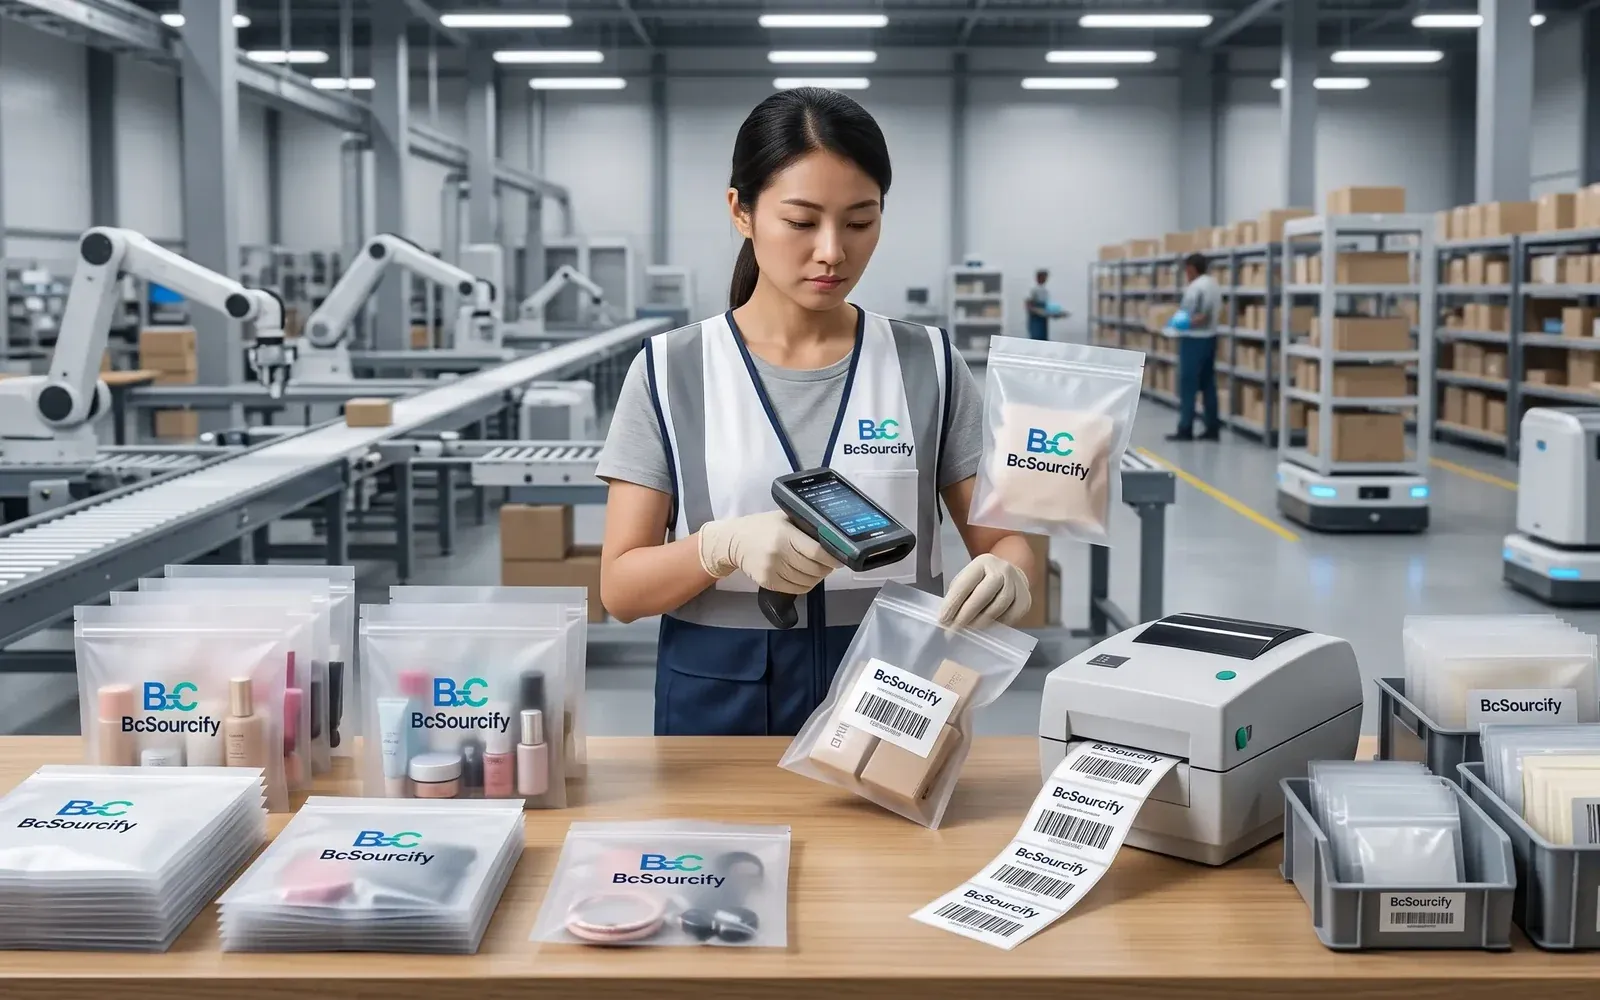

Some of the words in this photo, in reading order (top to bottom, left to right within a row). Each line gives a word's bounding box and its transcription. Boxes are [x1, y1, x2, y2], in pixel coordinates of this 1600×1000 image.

[843, 442, 914, 458] BcSourcify
[1006, 453, 1089, 481] BcSourcify
[874, 669, 942, 706] BcSourcify
[1480, 697, 1562, 715] BcSourcify
[121, 716, 221, 737] BcSourcify
[411, 712, 511, 733] BcSourcify
[1092, 743, 1163, 764] BcSourcify
[1052, 786, 1124, 815] BcSourcify
[17, 817, 138, 834] BcSourcify
[319, 849, 435, 866] BcSourcify
[1015, 847, 1088, 877] BcSourcify
[612, 873, 726, 888] BcSourcify
[964, 889, 1040, 919] BcSourcify
[1390, 896, 1452, 909] BcSourcify
